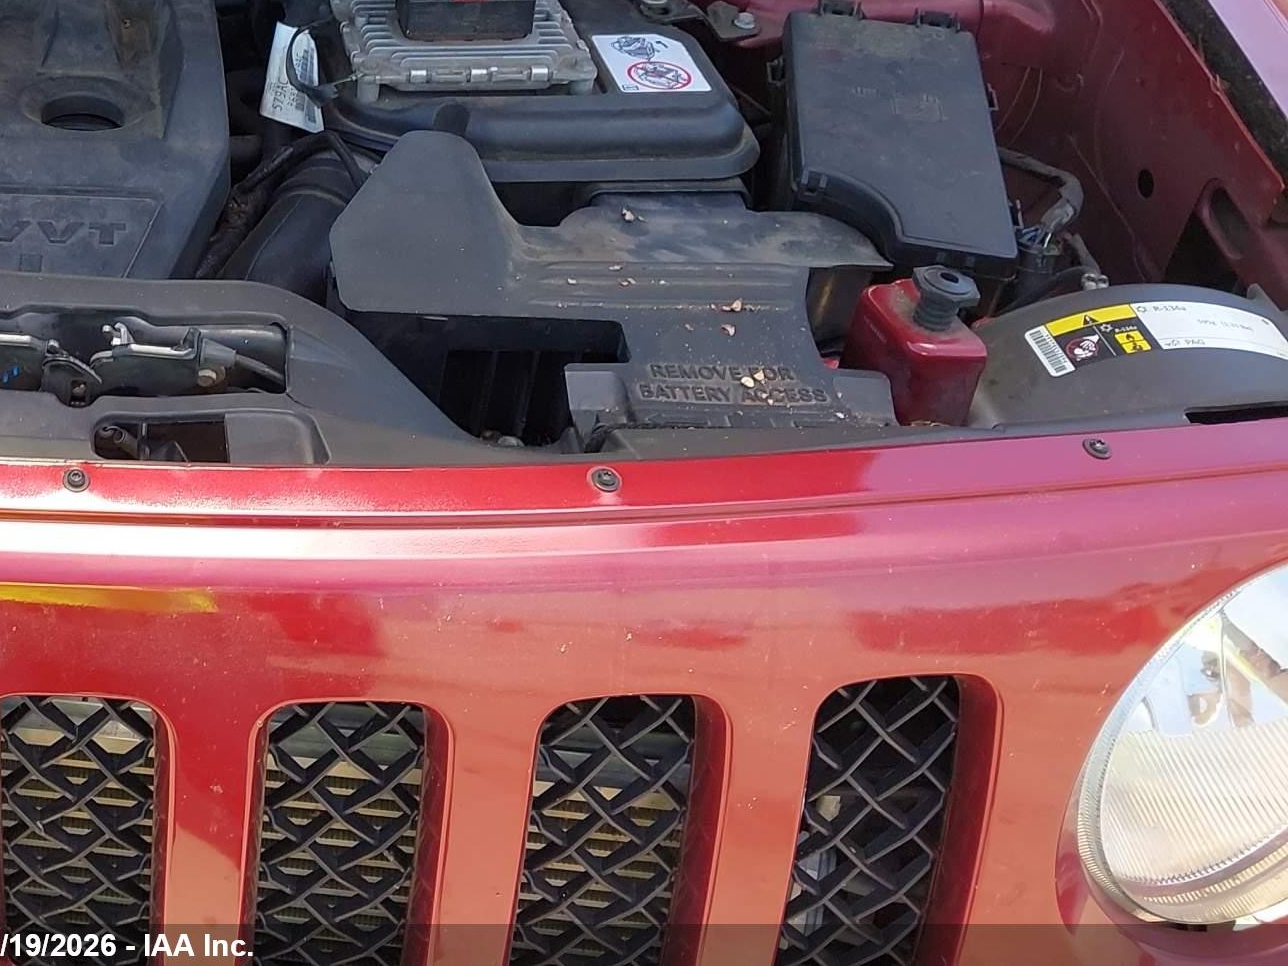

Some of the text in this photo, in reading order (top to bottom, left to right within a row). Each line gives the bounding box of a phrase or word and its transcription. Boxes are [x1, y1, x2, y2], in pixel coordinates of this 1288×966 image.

[649, 364, 795, 381] REMOVE FOR
[639, 383, 828, 403] BATTERY ACCESS
